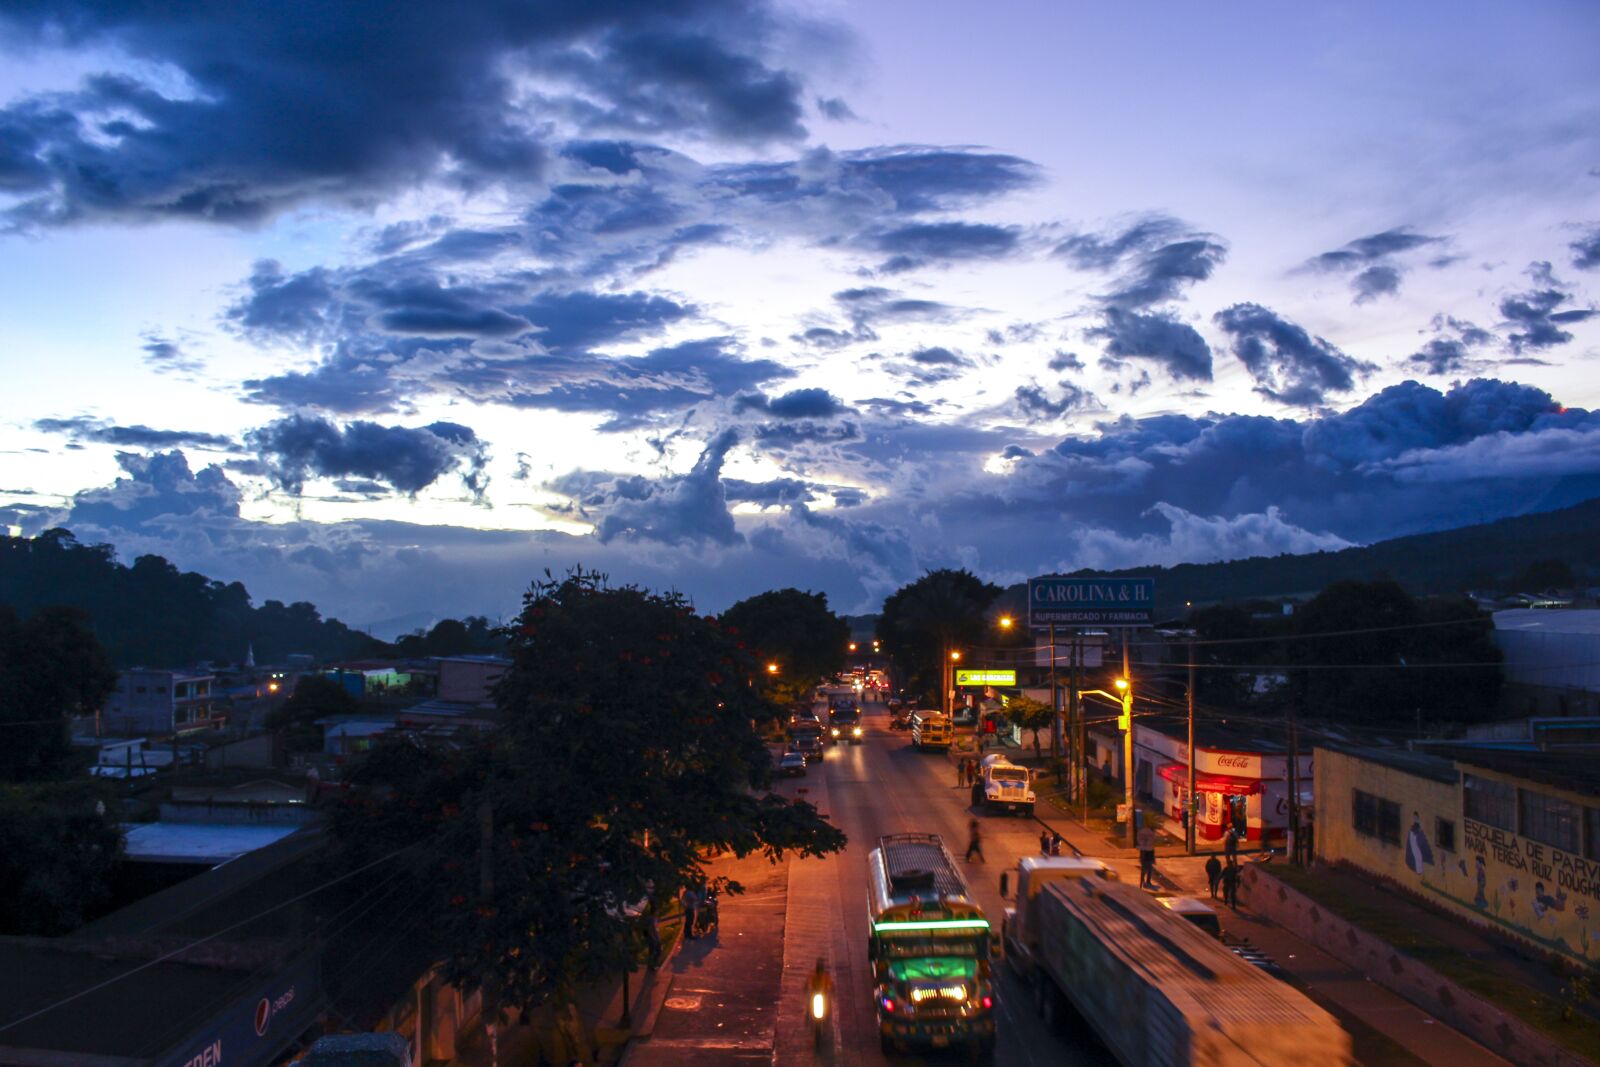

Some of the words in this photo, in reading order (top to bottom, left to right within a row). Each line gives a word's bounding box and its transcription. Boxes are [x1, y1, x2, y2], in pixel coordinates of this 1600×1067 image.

[1034, 584, 1114, 602] CAROLINA
[1118, 584, 1131, 602] &
[1135, 584, 1150, 602] H.
[1035, 611, 1100, 621] SUPERMERCADO
[1102, 612, 1107, 620] Y
[1109, 612, 1149, 621] FARMACIA
[1464, 819, 1520, 853] ESCUELA
[1526, 840, 1544, 861] DE
[1464, 834, 1488, 857] MARIA
[1491, 845, 1528, 873] TERESA
[1532, 860, 1553, 882] RUIZ
